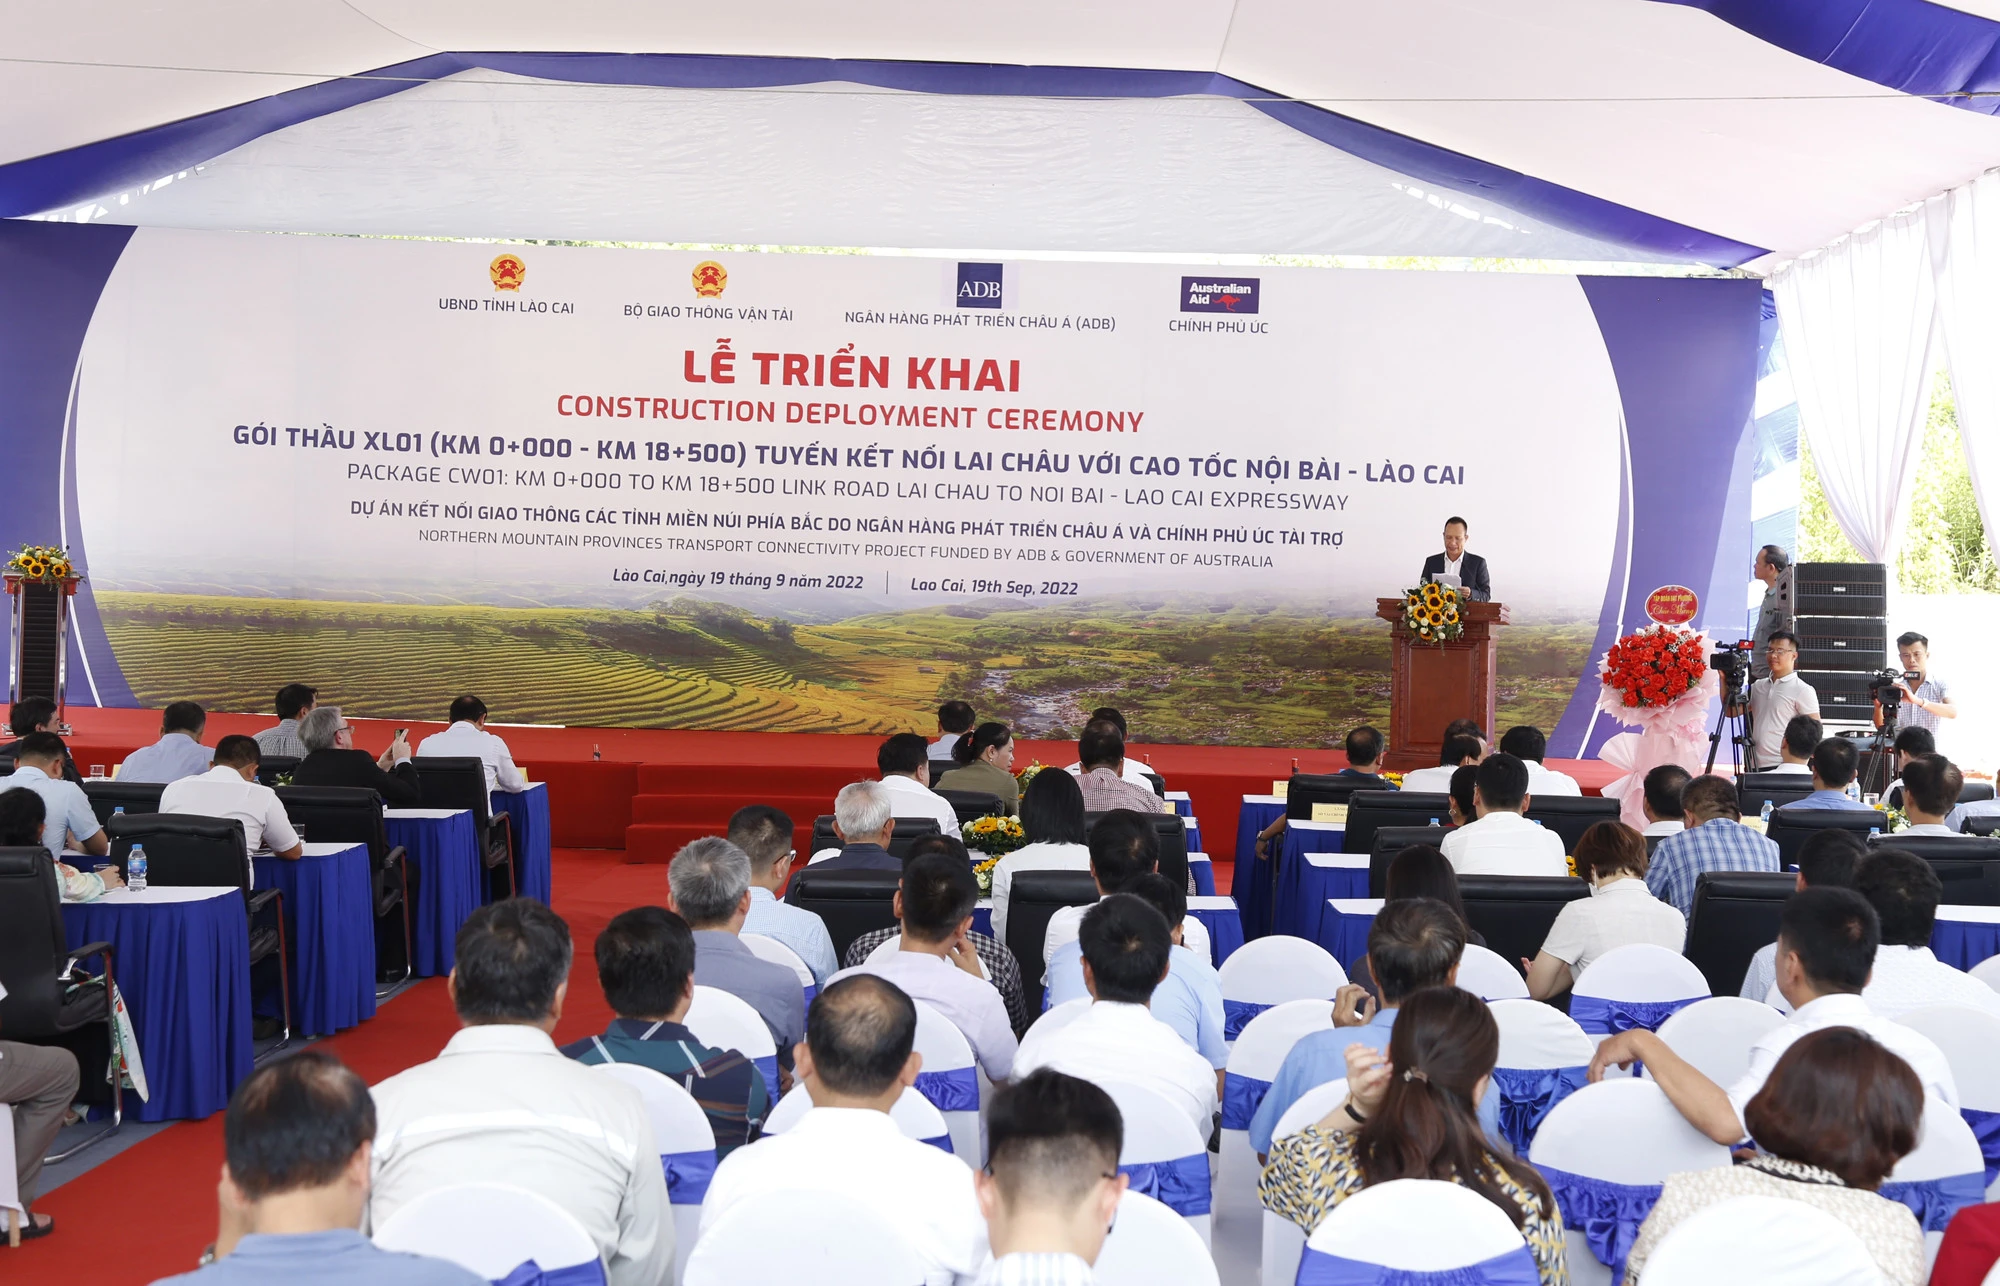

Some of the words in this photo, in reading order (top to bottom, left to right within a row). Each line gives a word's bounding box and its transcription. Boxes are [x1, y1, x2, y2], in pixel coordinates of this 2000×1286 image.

[958, 281, 1000, 298] ADB
[1189, 283, 1252, 294] Australian
[1189, 294, 1210, 304] Aid
[439, 298, 478, 310] UBND
[483, 298, 515, 311] TỈNH
[520, 299, 547, 313] LÀO
[552, 303, 573, 313] CAI
[624, 303, 642, 319] BỘ
[648, 306, 680, 317] GIAO
[685, 305, 733, 319] THÔNG
[738, 307, 767, 322] VẬN
[772, 307, 792, 320] TẢI
[846, 310, 884, 323] NGÂN
[890, 311, 928, 324] HÀNG
[934, 312, 970, 325] PHÁT
[975, 314, 1014, 327] TRIỂN
[1020, 315, 1057, 328] CHÂU
[1062, 314, 1071, 328] Á
[1076, 316, 1115, 332] (ADB)
[1169, 318, 1212, 332] CHÍNH
[1217, 319, 1245, 333] PHỦ
[1251, 320, 1268, 333] ÚC
[684, 338, 736, 384] LỄ
[752, 343, 889, 388] TRIỂN
[908, 357, 1020, 392] KHAI
[558, 395, 774, 422] CONSTRUCTION
[786, 402, 977, 428] DEPLOYMENT
[988, 408, 1143, 432] CEREMONY
[234, 422, 276, 445] GÓI
[286, 423, 354, 449] THẦU
[364, 432, 421, 452] XL01
[431, 431, 480, 457] (KM
[490, 437, 571, 457] 0+000
[598, 440, 636, 460] KM
[645, 442, 746, 468] 18+500)
[755, 441, 837, 466] TUYẾN
[847, 443, 894, 467] KẾT
[903, 444, 945, 469] NỐI
[955, 451, 992, 471] LAI
[1002, 449, 1069, 473] CHÂU
[1078, 451, 1120, 474] VỚI
[1130, 456, 1180, 476] CAO
[1189, 452, 1237, 477] TỐC
[1246, 456, 1289, 484] NỘI
[1299, 457, 1339, 480] BÀI
[1366, 459, 1414, 483] LÀO
[1424, 465, 1463, 484] CAI
[348, 464, 440, 482] PACKAGE
[449, 468, 507, 485] CW01:
[516, 470, 545, 486] KM
[554, 472, 621, 489] 0+000
[629, 474, 654, 490] TO
[663, 475, 691, 491] KM
[700, 476, 774, 494] 18+500
[783, 479, 826, 495] LINK
[834, 481, 889, 497] ROAD
[898, 483, 926, 498] LAI
[935, 484, 989, 500] CHAU
[997, 485, 1022, 501] TO
[1031, 486, 1063, 502] NOI
[1072, 487, 1103, 503] BAI
[1125, 489, 1164, 505] LAO
[1172, 490, 1202, 506] CAI
[1211, 491, 1348, 510] EXPRESSWAY
[351, 500, 375, 518] DỰ
[379, 499, 402, 516] ÁN
[409, 500, 439, 517] KẾT
[445, 501, 472, 519] NỐI
[478, 506, 517, 520] GIAO
[523, 505, 580, 522] THÔNG
[586, 507, 617, 524] CÁC
[622, 508, 660, 525] TỈNH
[666, 509, 707, 527] MIỀN
[714, 510, 741, 528] NÚI
[747, 513, 785, 529] PHÍA
[791, 512, 822, 530] BẮC
[829, 518, 851, 531] DO
[857, 516, 903, 533] NGÂN
[909, 517, 955, 534] HÀNG
[961, 519, 1004, 535] PHÁT
[1010, 519, 1057, 537] TRIỂN
[1063, 522, 1107, 538] CHÂU
[1113, 523, 1123, 539] Á
[1130, 524, 1151, 540] VÀ
[1157, 525, 1207, 541] CHÍNH
[1213, 526, 1247, 542] PHỦ
[1253, 527, 1274, 543] ÚC
[1280, 528, 1304, 544] TÀI
[1310, 531, 1343, 549] TRỢ
[420, 530, 497, 543] NORTHERN
[502, 533, 578, 546] MOUNTAIN
[583, 536, 662, 549] PROVINCES
[667, 538, 753, 552] TRANSPORT
[758, 541, 860, 555] CONNECTIVITY
[865, 544, 926, 557] PROJECT
[931, 546, 989, 559] FUNDED
[994, 548, 1012, 559] BY
[1017, 549, 1046, 560] ADB
[1051, 550, 1060, 561] &
[1066, 550, 1165, 564] GOVERNMENT
[1170, 553, 1189, 564] OF
[1194, 554, 1273, 567] AUSTRALIA
[613, 568, 639, 581] Lào
[644, 570, 705, 587] Cai,ngày
[711, 572, 725, 584] 19
[730, 572, 771, 589] tháng
[776, 574, 785, 586] 9
[789, 574, 821, 587] năm
[826, 575, 863, 588] 2022
[911, 578, 936, 591] Lao
[942, 579, 965, 593] Cai,
[972, 580, 1002, 592] 19th
[1006, 581, 1035, 597] Sep,
[1040, 582, 1078, 595] 2022
